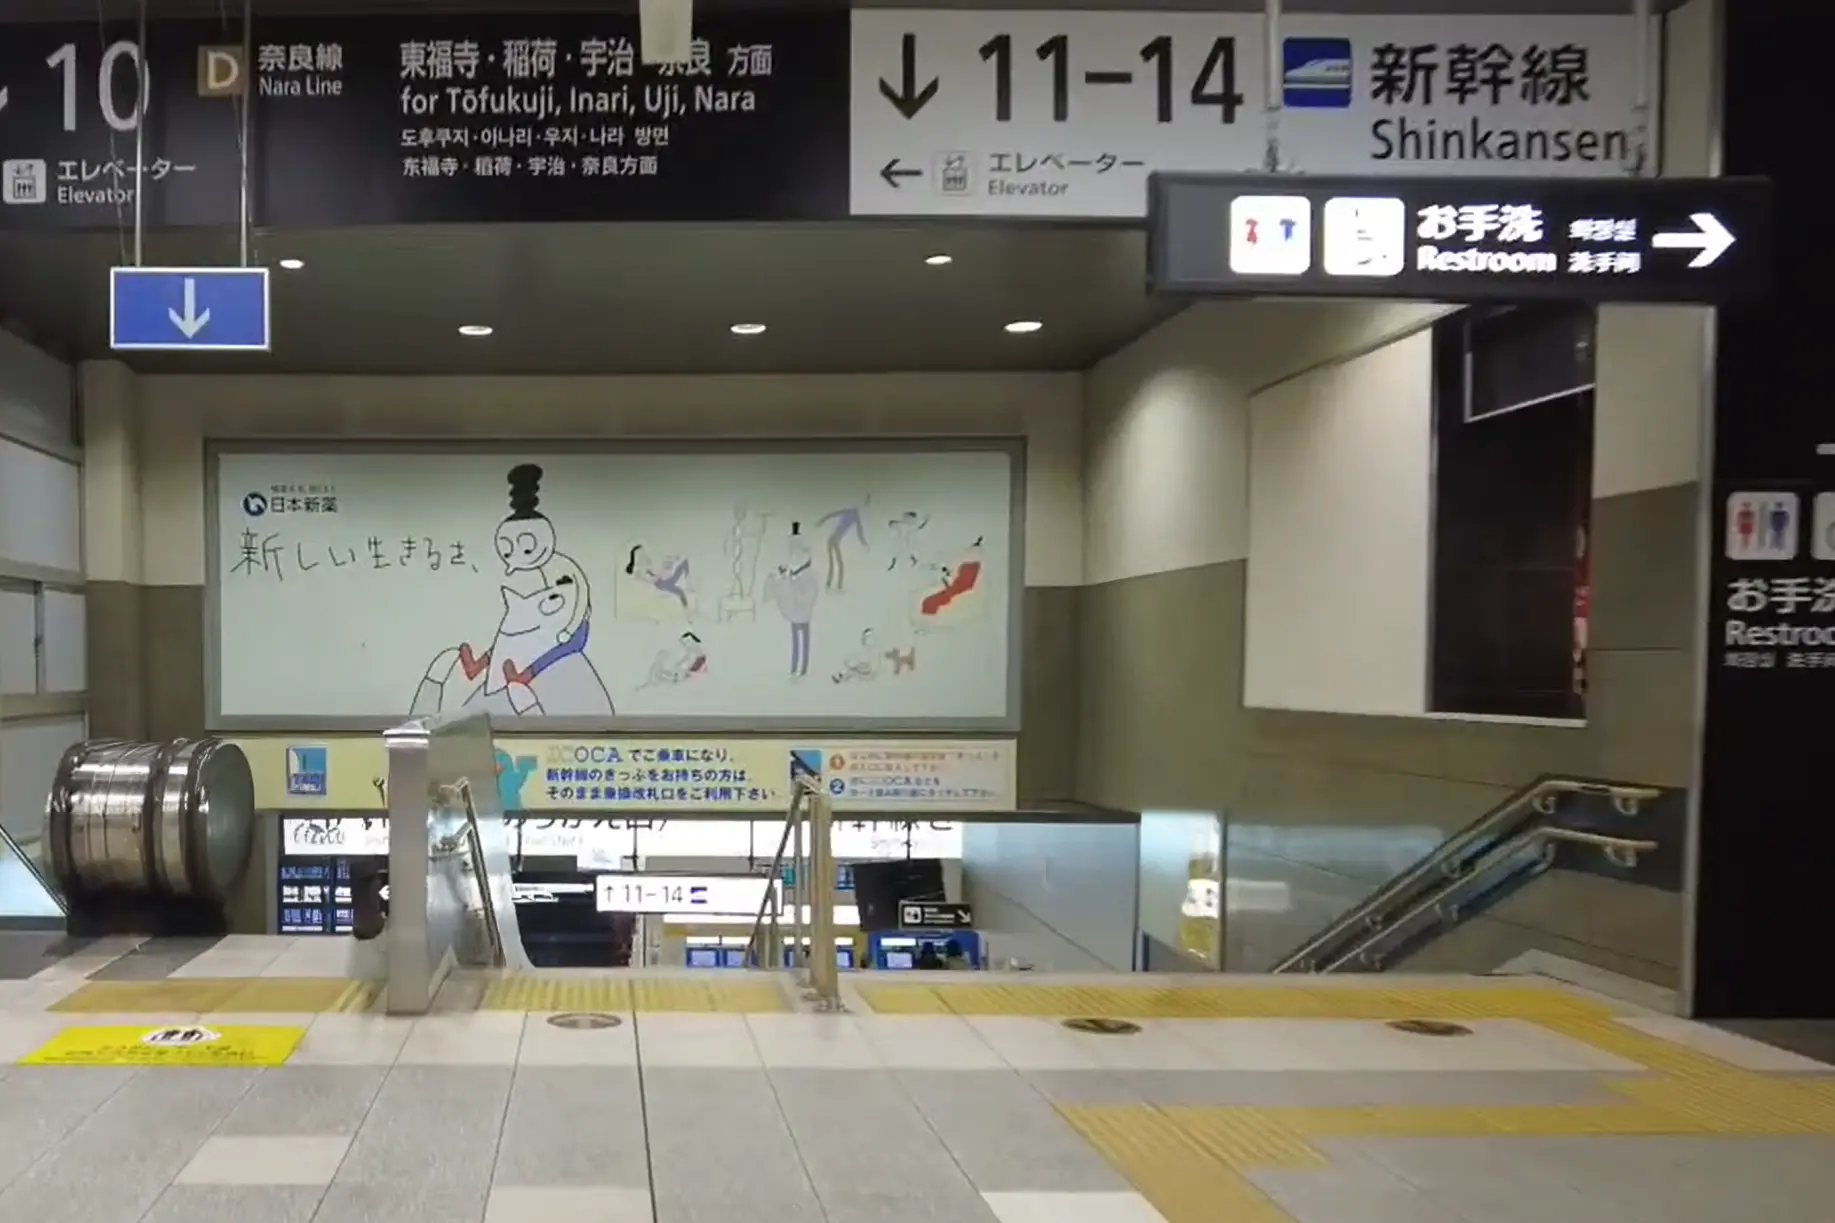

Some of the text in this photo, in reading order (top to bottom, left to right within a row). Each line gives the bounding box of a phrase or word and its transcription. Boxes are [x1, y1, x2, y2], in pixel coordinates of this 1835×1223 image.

[206, 51, 240, 90] D
[258, 43, 344, 71] 奈良線
[728, 44, 773, 77] 方面
[46, 40, 150, 132] 10
[259, 76, 343, 96] Nara Line
[1370, 42, 1590, 106] 新幹線
[401, 85, 756, 119] for Tōfukuji, Inari, Uji, Nara
[1371, 116, 1628, 162] Shinkansen
[57, 157, 196, 182] エレベーター
[989, 151, 1146, 173] エレベーター
[57, 186, 136, 204] Elevator
[988, 180, 1069, 197] Elevator
[1416, 203, 1544, 243] お手洗
[1416, 245, 1558, 273] Restroom
